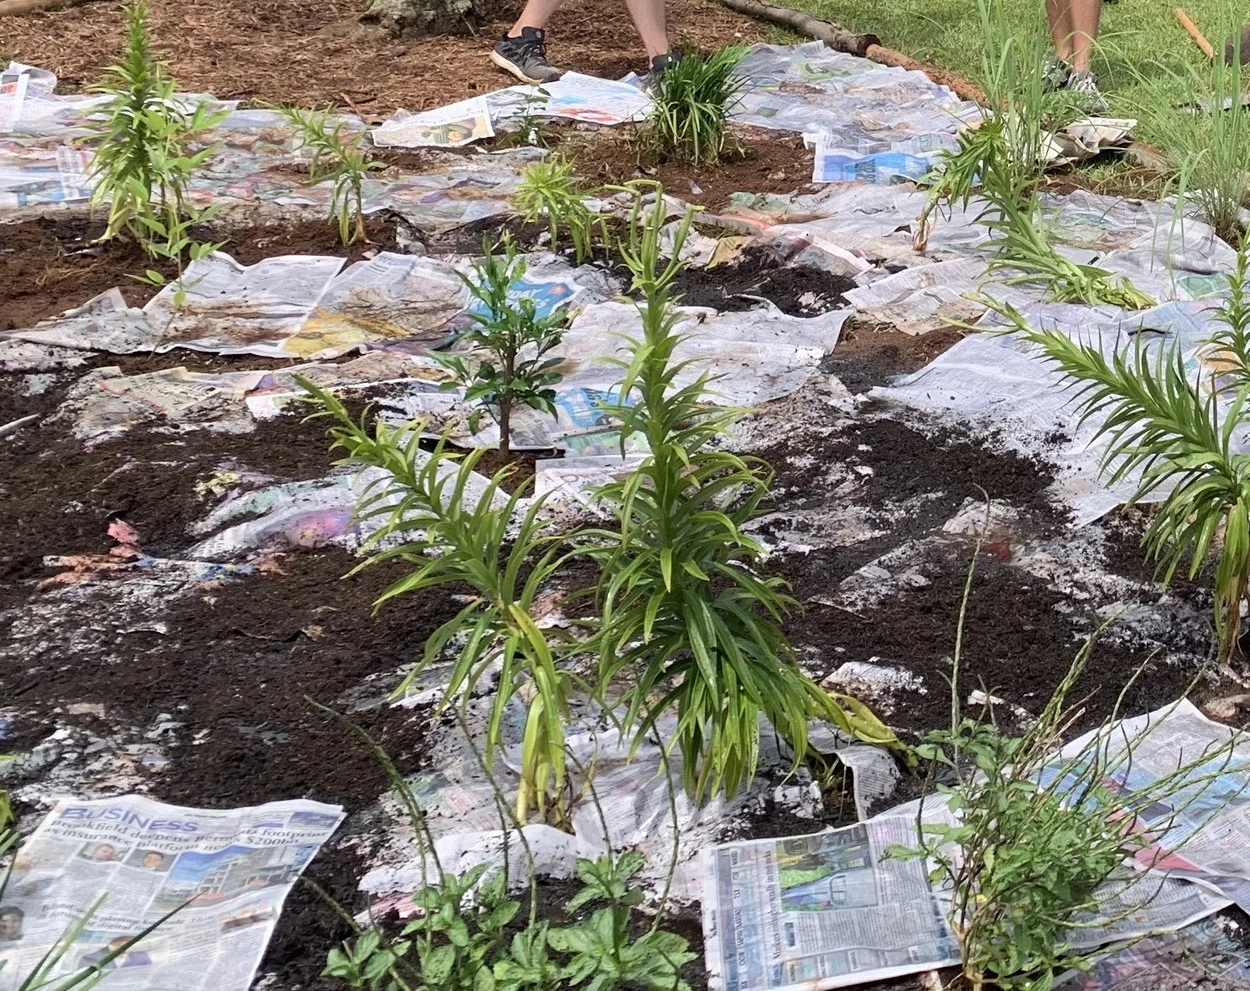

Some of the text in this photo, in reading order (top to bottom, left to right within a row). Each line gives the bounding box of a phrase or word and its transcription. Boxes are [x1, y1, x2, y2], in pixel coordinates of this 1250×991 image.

[58, 807, 199, 832] BUSINESS
[63, 830, 133, 845] insurance
[136, 841, 198, 852] platform
[131, 832, 190, 844] deepens
